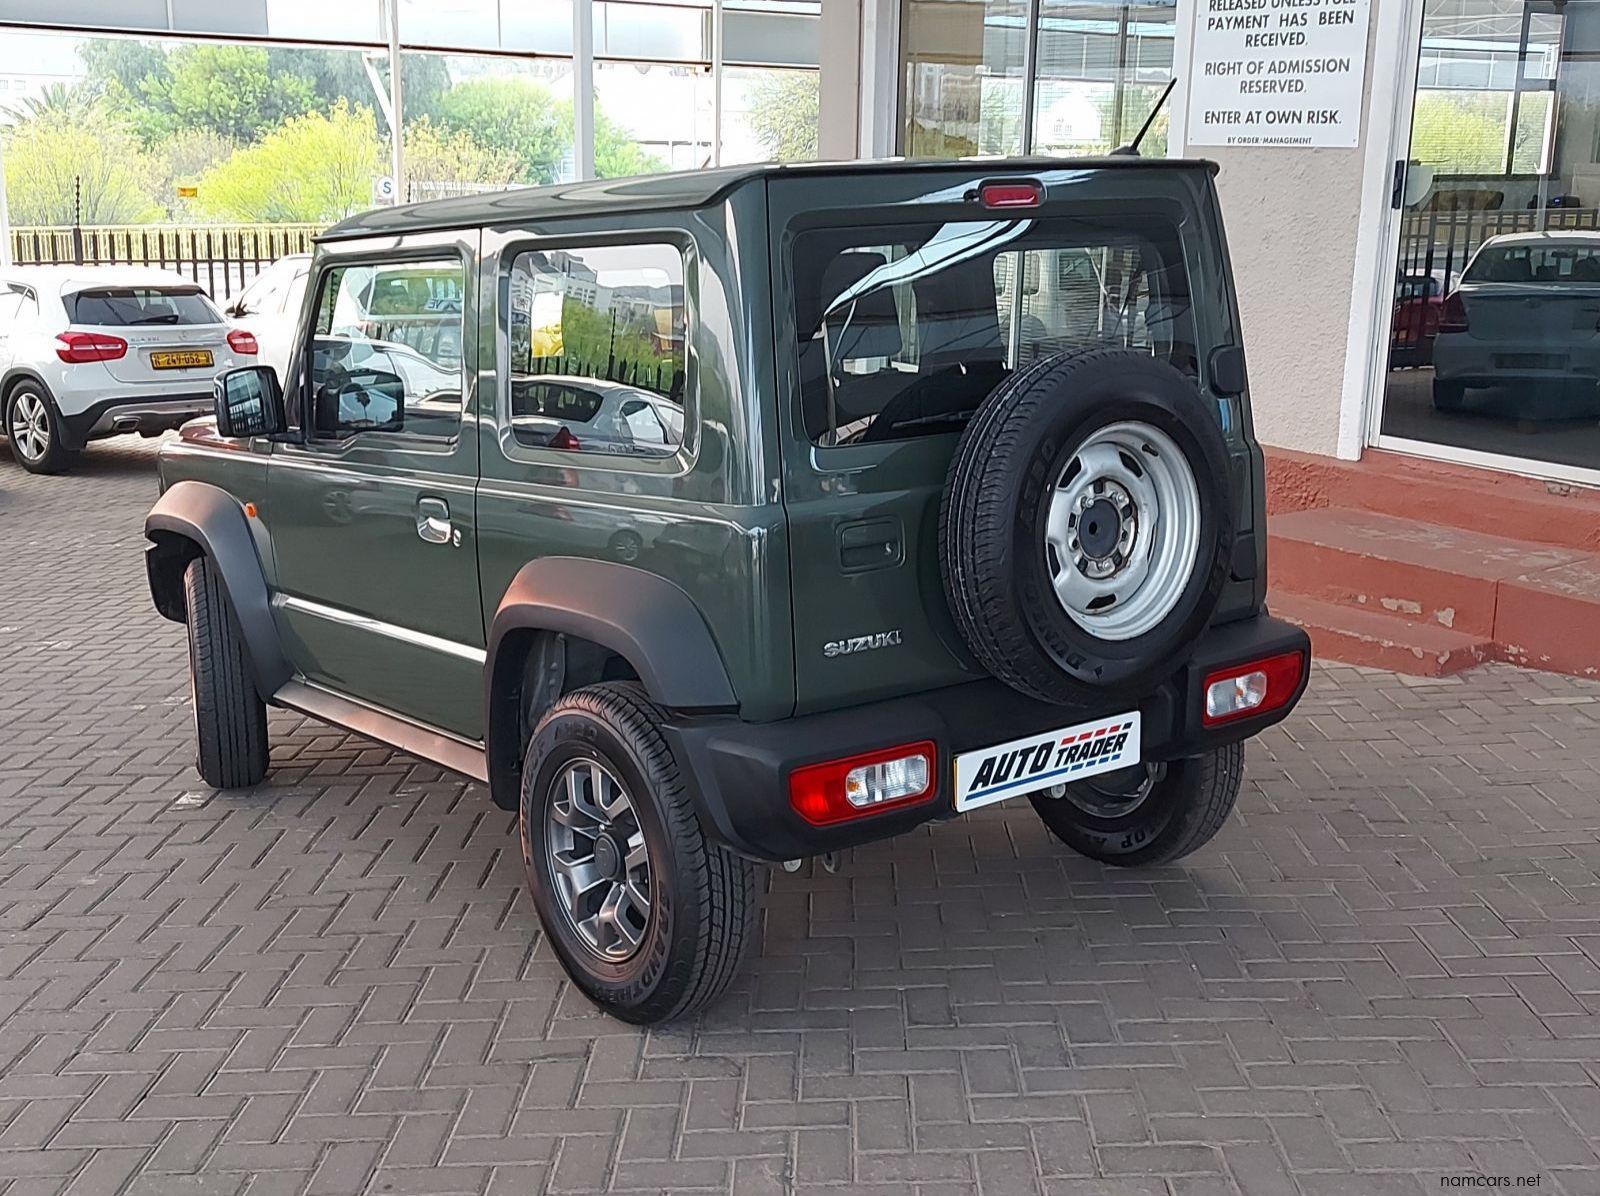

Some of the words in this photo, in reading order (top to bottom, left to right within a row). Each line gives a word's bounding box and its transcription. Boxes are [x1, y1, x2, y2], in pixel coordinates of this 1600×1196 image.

[1209, 0, 1267, 12] RELEASED
[1207, 14, 1270, 31] PAYMENT
[1279, 12, 1308, 28] HAS
[1318, 9, 1355, 26] BEEN
[1245, 31, 1308, 48] RECEIVED.
[1204, 61, 1243, 76] RIGHT
[1246, 60, 1265, 75] OF
[1267, 58, 1351, 75] ADMISSION
[1239, 79, 1307, 94] RESERVED.
[1204, 110, 1241, 125] ENTER
[1244, 110, 1262, 125] AT
[1265, 110, 1303, 125] OWN
[1306, 110, 1342, 125] RISK.
[1227, 136, 1236, 144] BY
[382, 181, 392, 194] S
[823, 629, 902, 658] SUZUKI
[968, 741, 1056, 792] AUTO
[1054, 732, 1129, 768] TRADER
